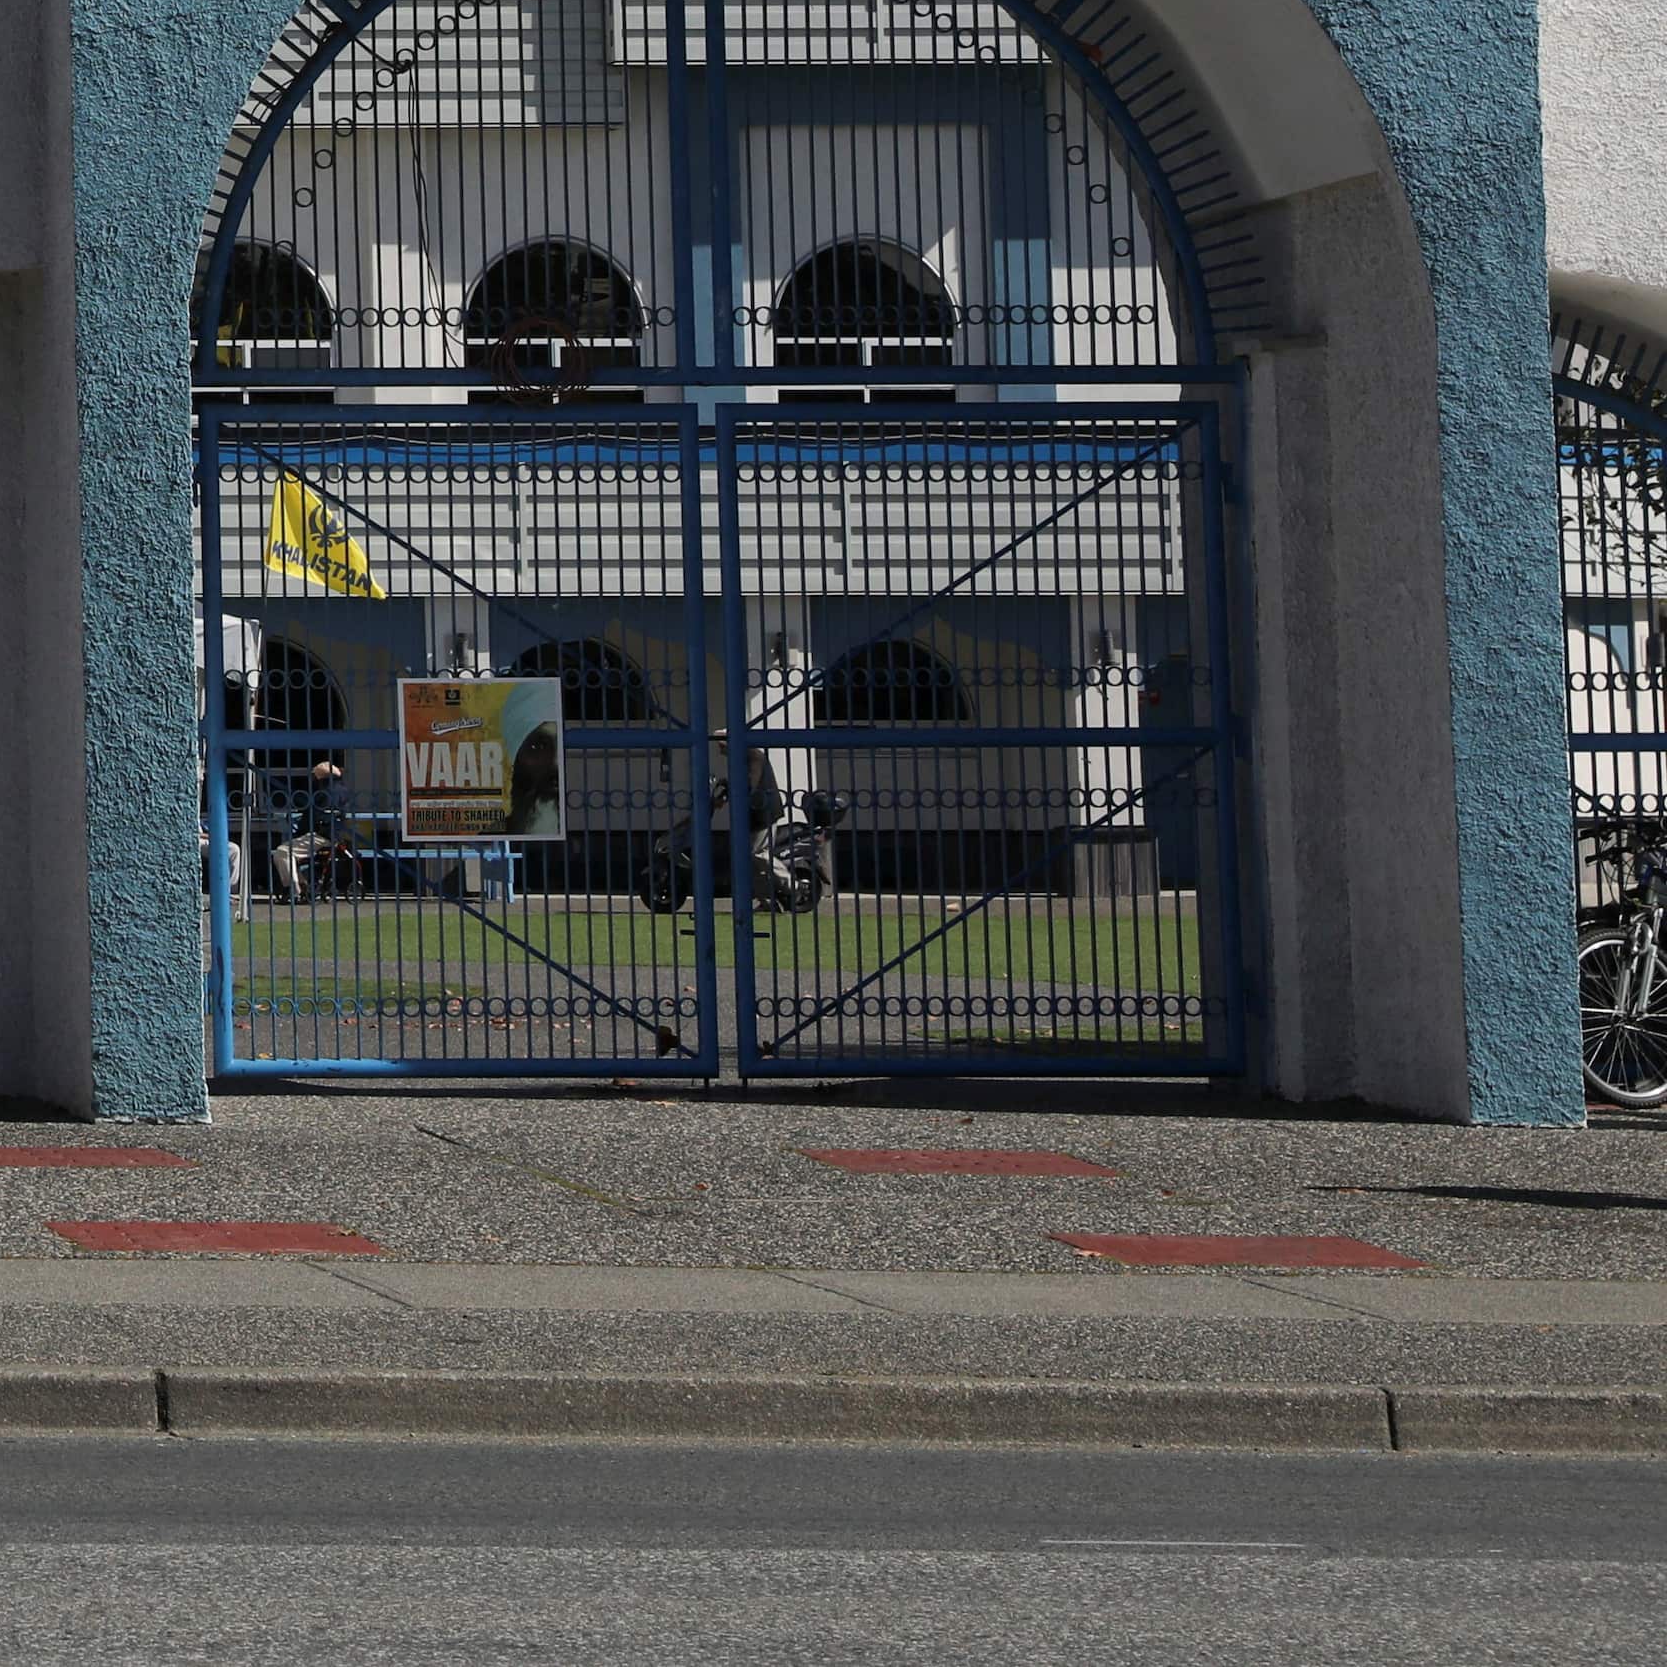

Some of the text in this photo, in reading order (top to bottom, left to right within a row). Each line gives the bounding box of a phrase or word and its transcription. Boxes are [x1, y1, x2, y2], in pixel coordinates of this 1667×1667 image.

[406, 741, 504, 788] VAAR
[411, 810, 506, 822] TRIBUTE TO SHAHEED
